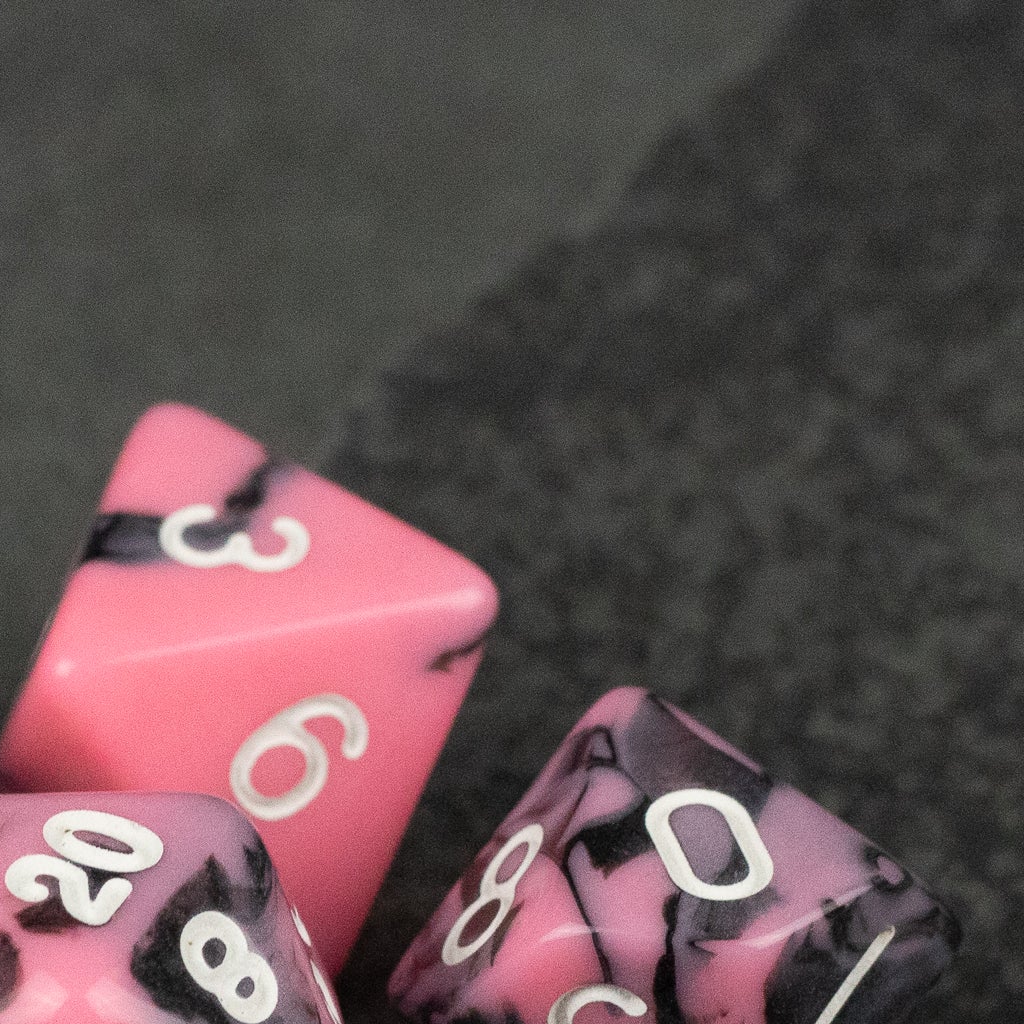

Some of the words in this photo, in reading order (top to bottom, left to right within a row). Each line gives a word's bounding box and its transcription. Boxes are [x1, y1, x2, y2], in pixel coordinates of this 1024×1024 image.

[159, 502, 311, 573] 3
[229, 694, 370, 822] 6
[3, 808, 166, 928] 20
[440, 821, 546, 968] 8
[643, 786, 776, 902] 0
